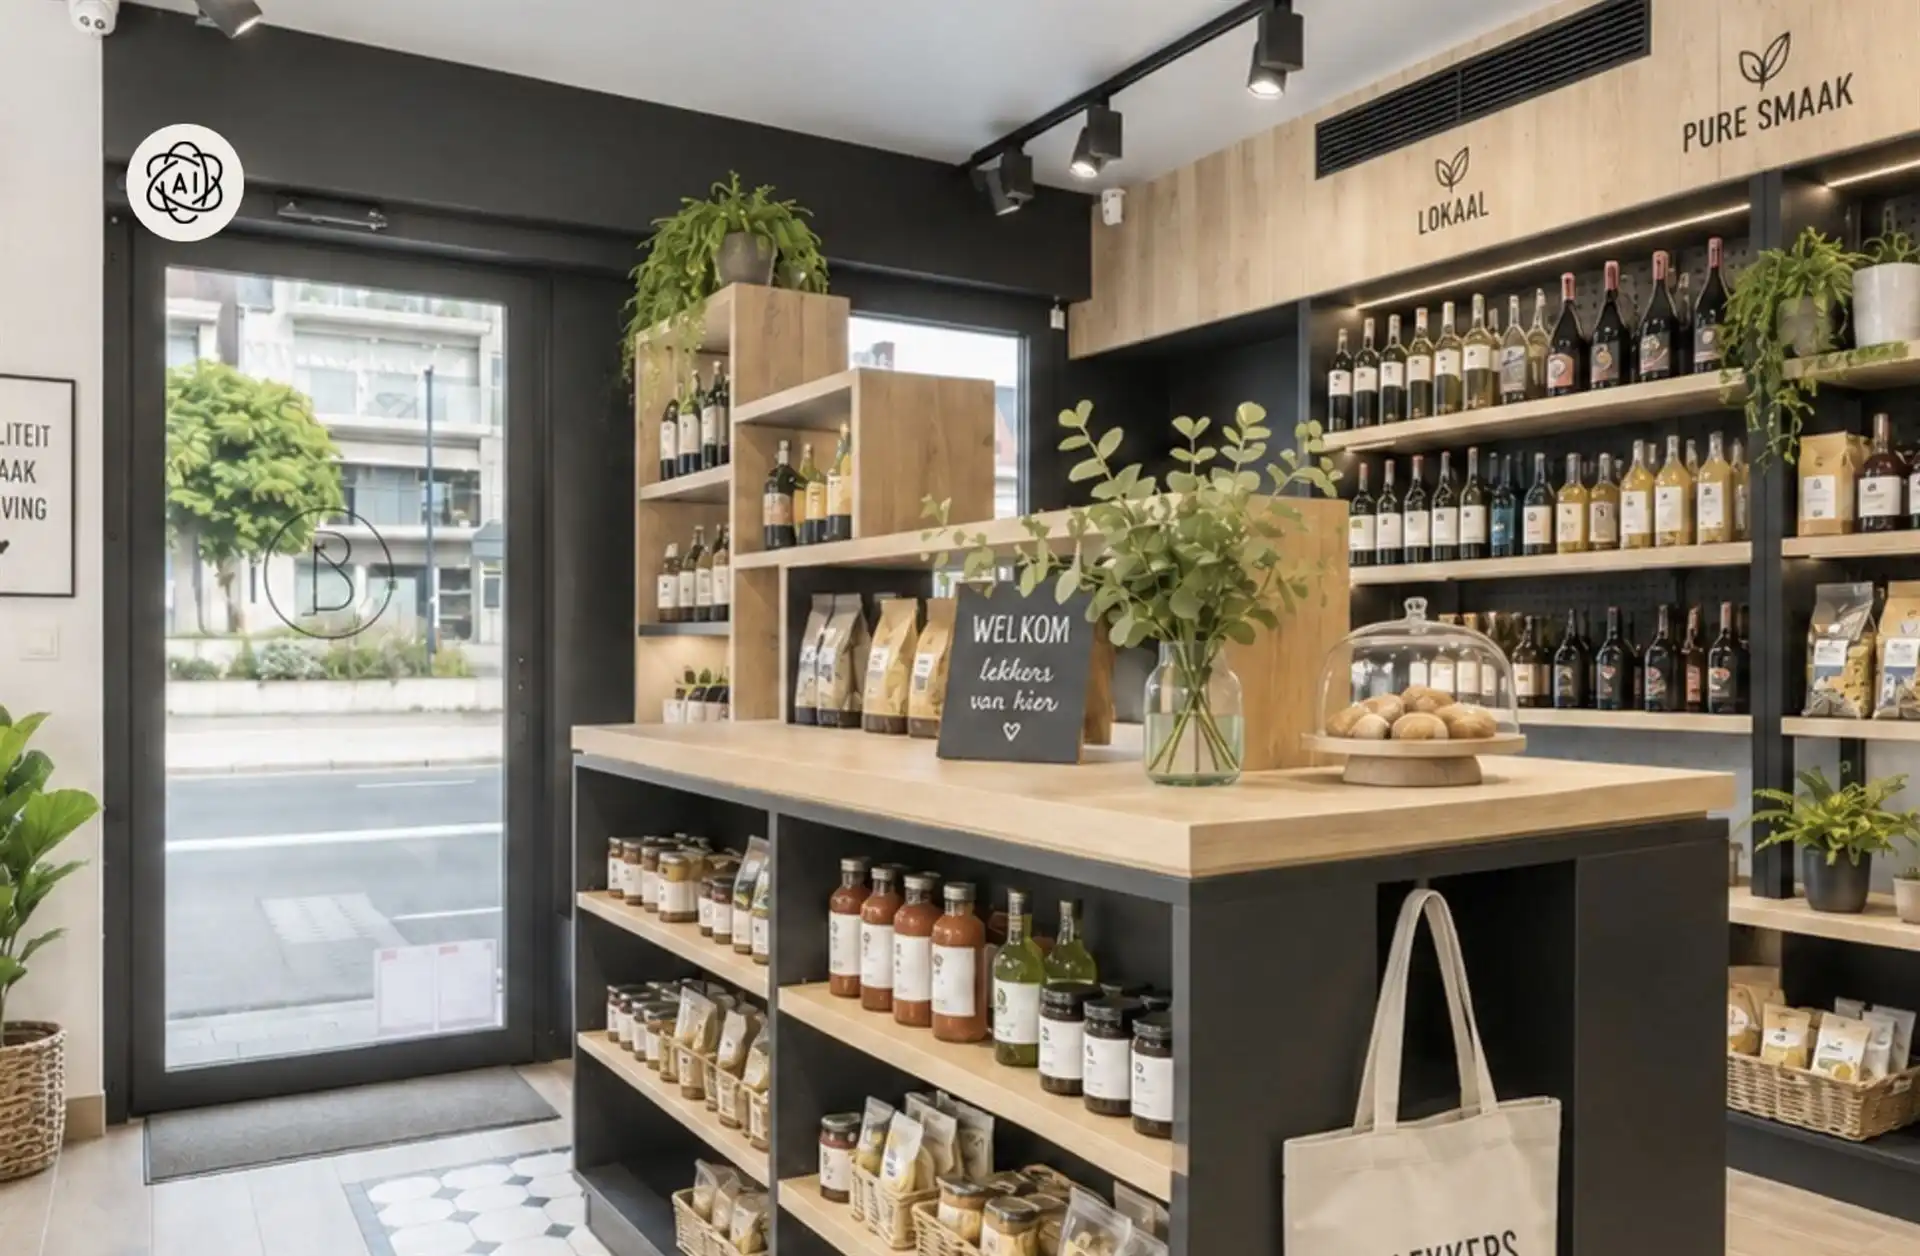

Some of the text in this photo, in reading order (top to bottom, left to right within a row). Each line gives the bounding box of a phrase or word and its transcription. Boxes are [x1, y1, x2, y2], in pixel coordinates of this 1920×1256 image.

[1683, 72, 1853, 153] PURE SMAAK
[1418, 190, 1489, 235] LOKAAL
[973, 614, 1070, 644] WELKOM
[979, 657, 1054, 683] lekkers
[970, 695, 1006, 711] van
